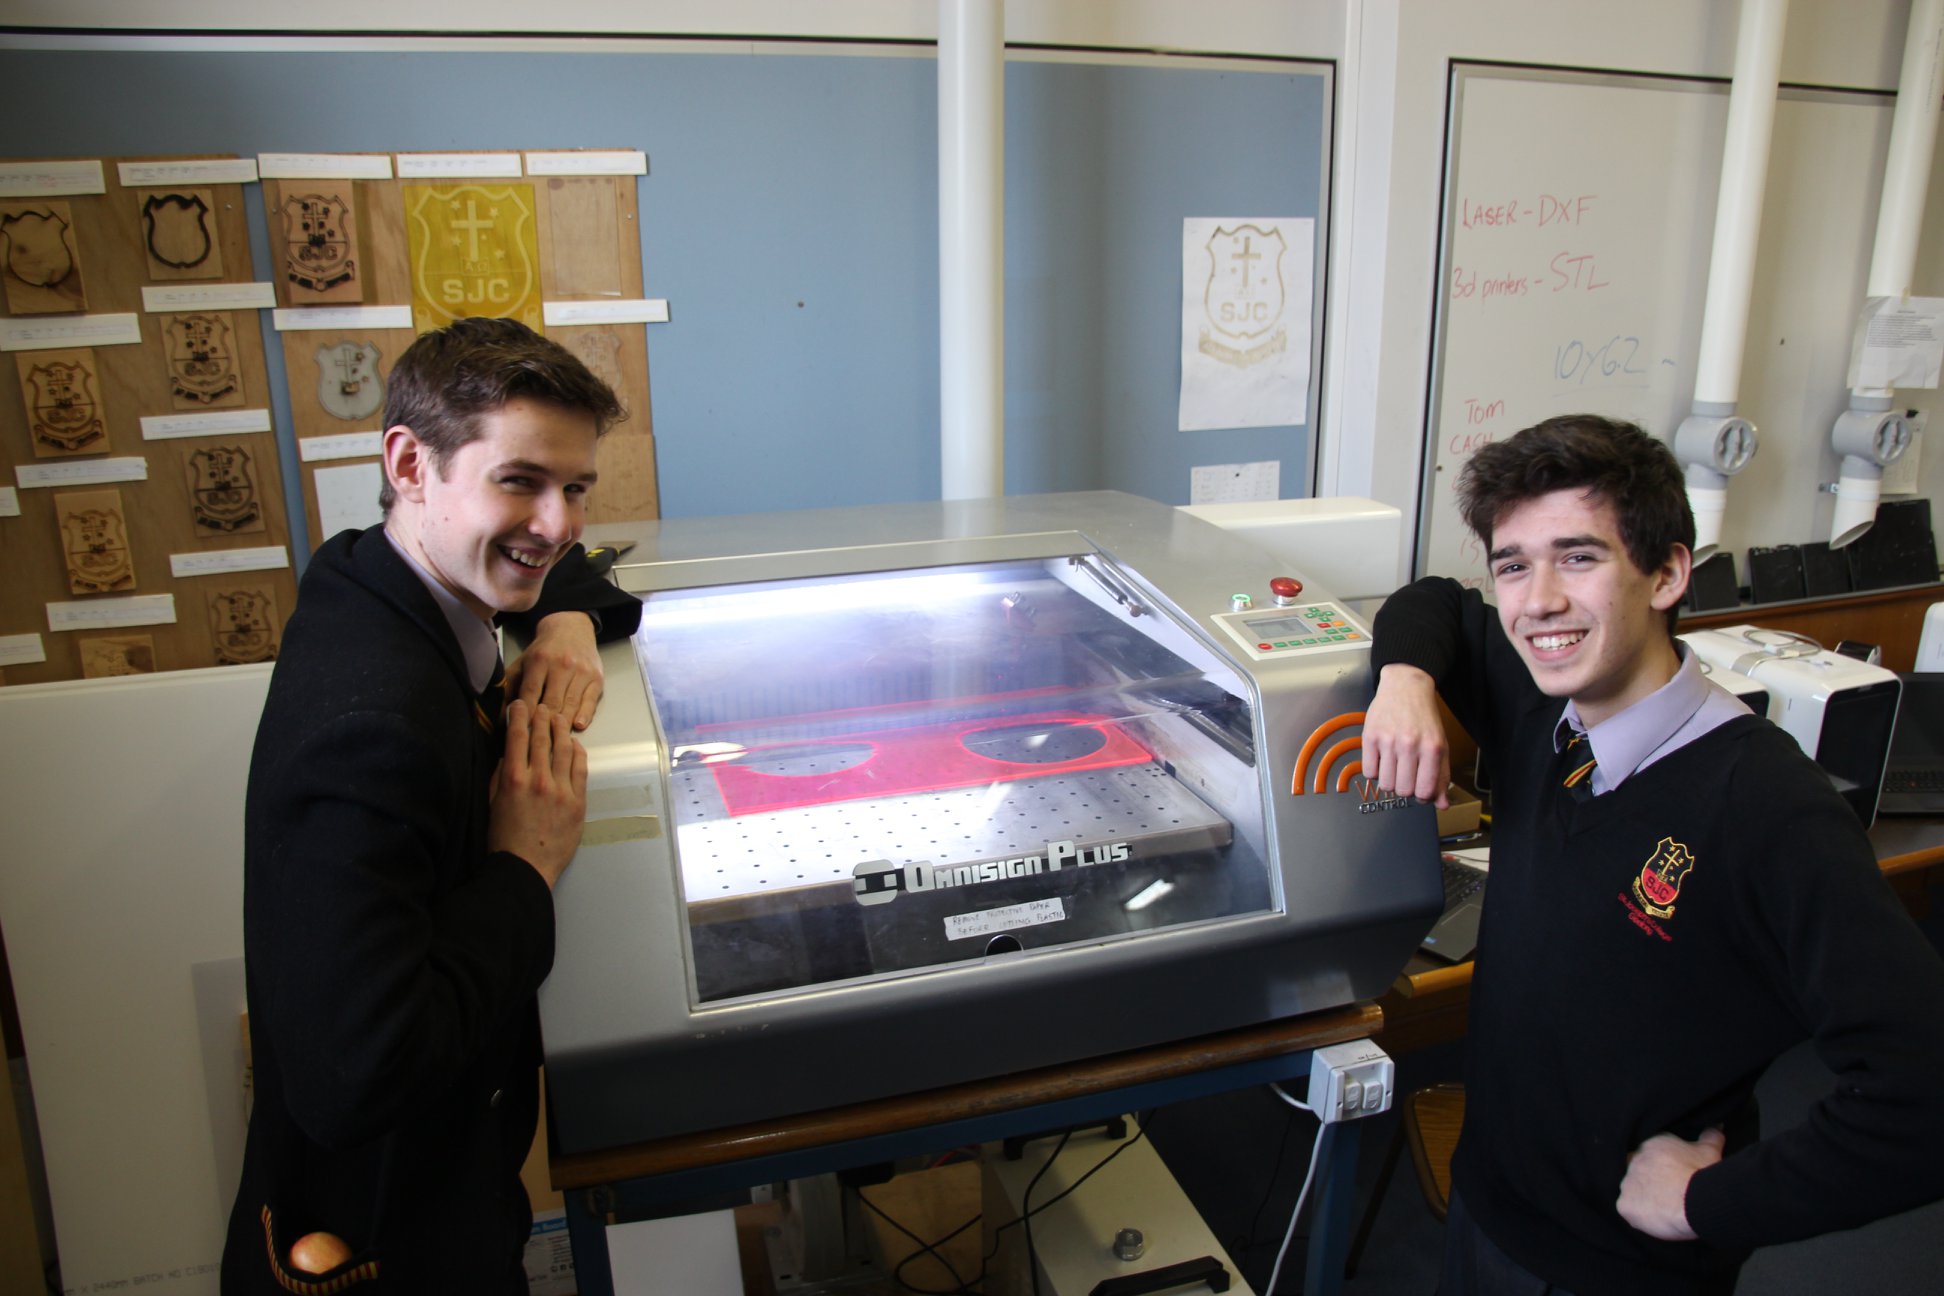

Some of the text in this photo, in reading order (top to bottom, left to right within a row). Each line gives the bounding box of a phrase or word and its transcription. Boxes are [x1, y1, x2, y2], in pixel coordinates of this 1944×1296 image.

[1550, 252, 1609, 292] STL
[443, 279, 509, 304] SJC
[1220, 301, 1268, 324] SJC
[1646, 876, 1669, 901] SJC
